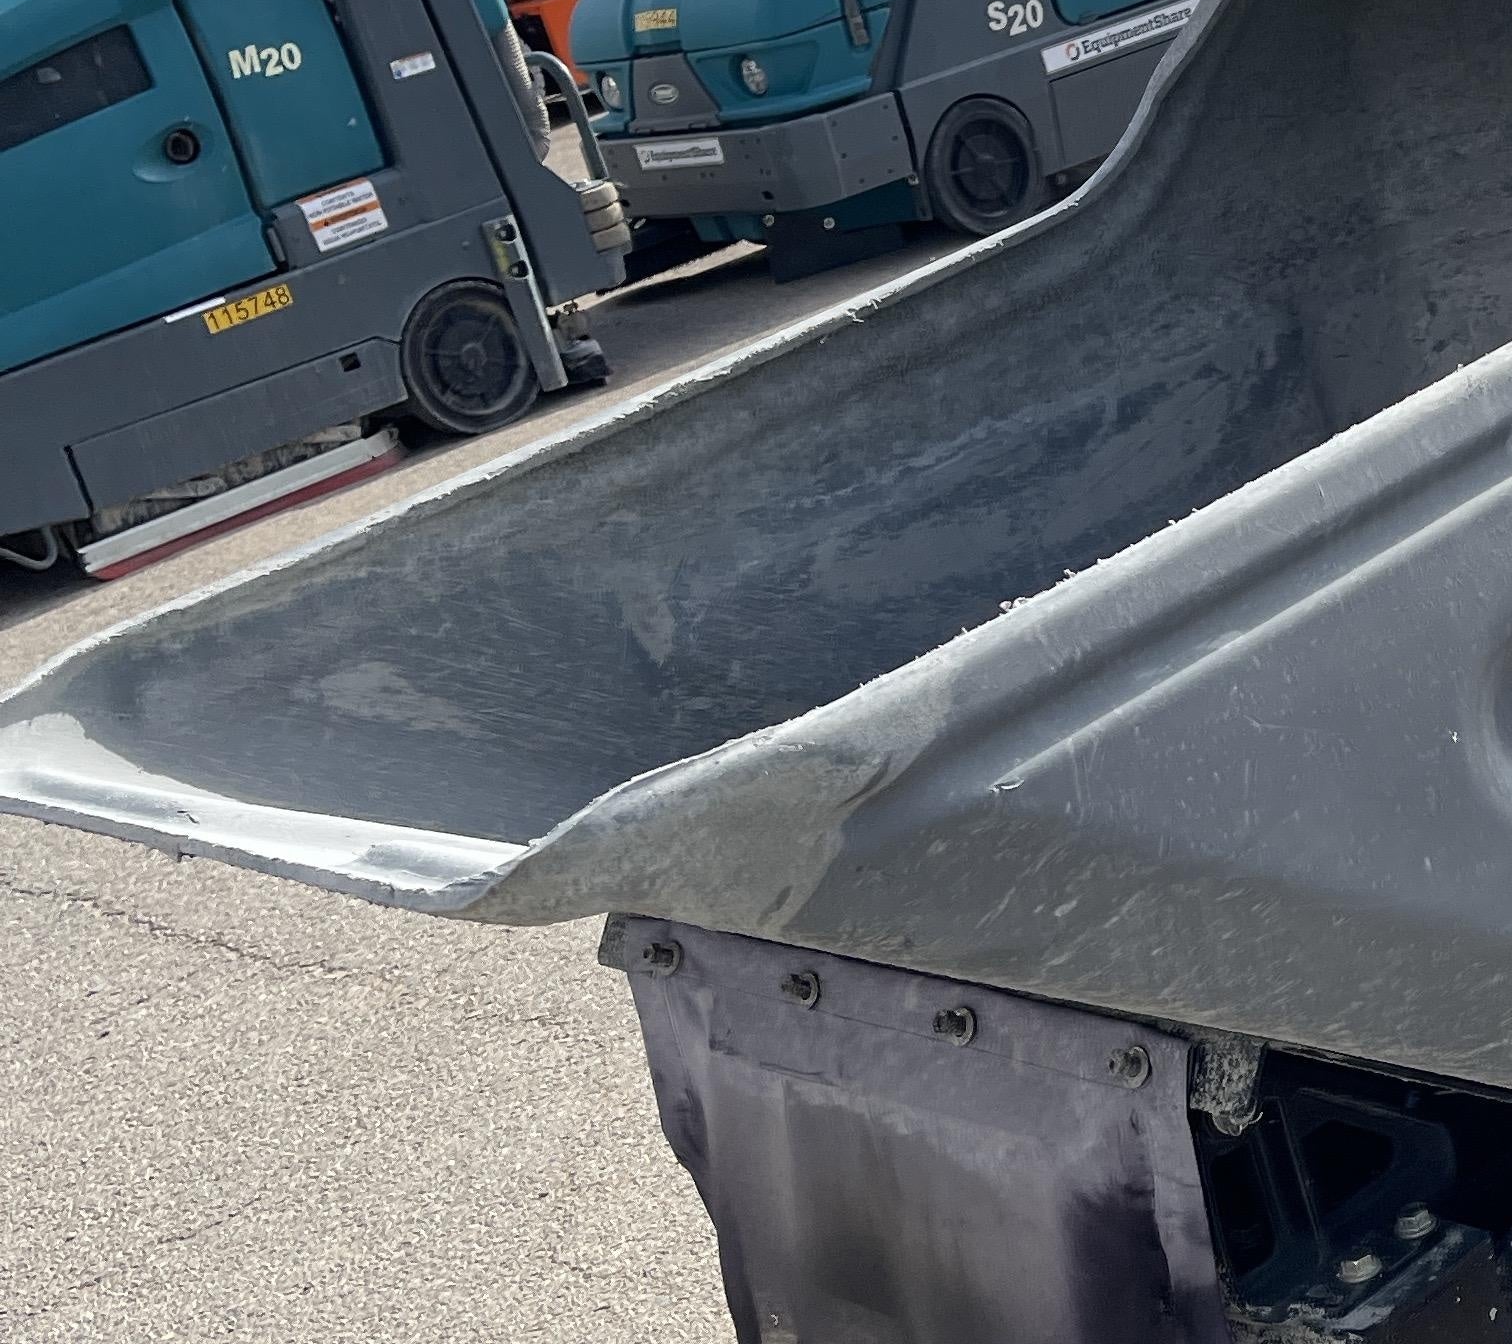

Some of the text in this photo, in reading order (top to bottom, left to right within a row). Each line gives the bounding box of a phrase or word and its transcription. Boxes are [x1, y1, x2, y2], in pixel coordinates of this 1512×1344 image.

[1080, 6, 1192, 54] EquipmentShare
[228, 42, 302, 79] M20
[207, 285, 290, 330] 115748
